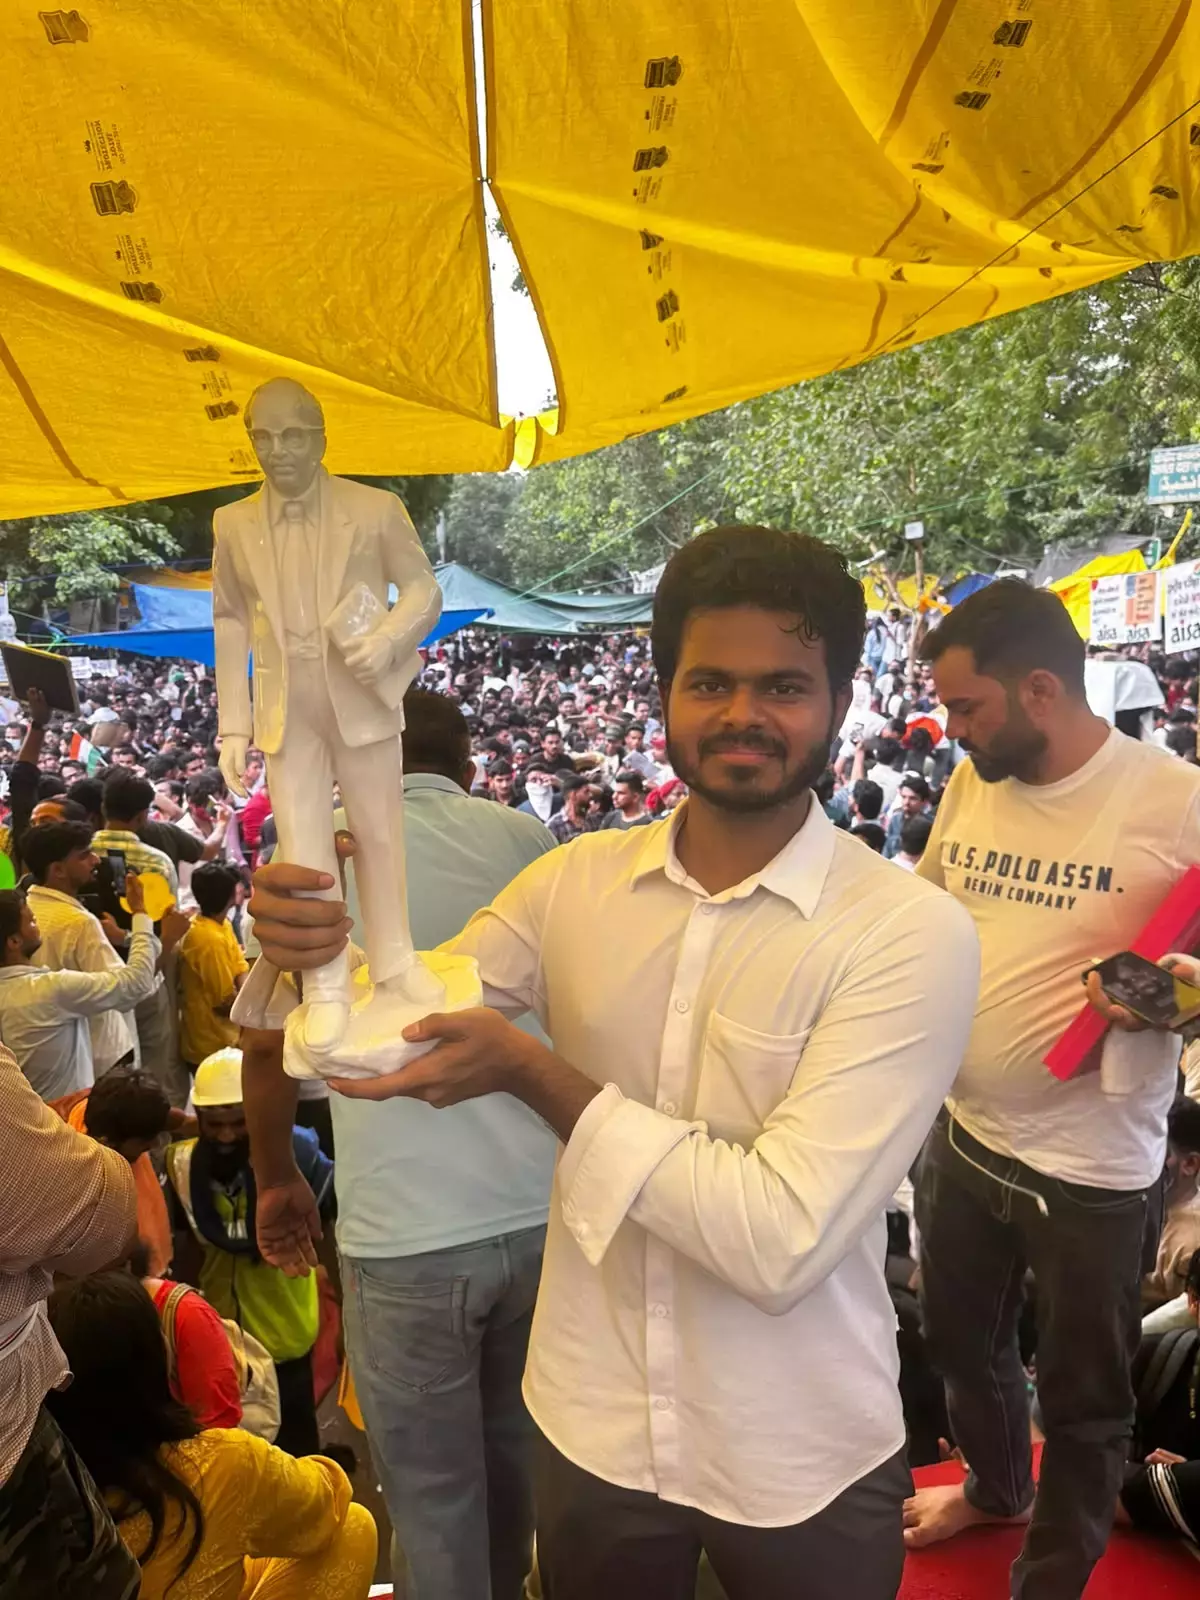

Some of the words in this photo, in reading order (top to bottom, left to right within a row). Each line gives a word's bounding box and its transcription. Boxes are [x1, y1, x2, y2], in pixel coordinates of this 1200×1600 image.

[1170, 620, 1200, 644] aisa
[964, 876, 1003, 898] DENIM
[1007, 887, 1077, 911] COMPANY
[1044, 861, 1124, 894] ASSN.
